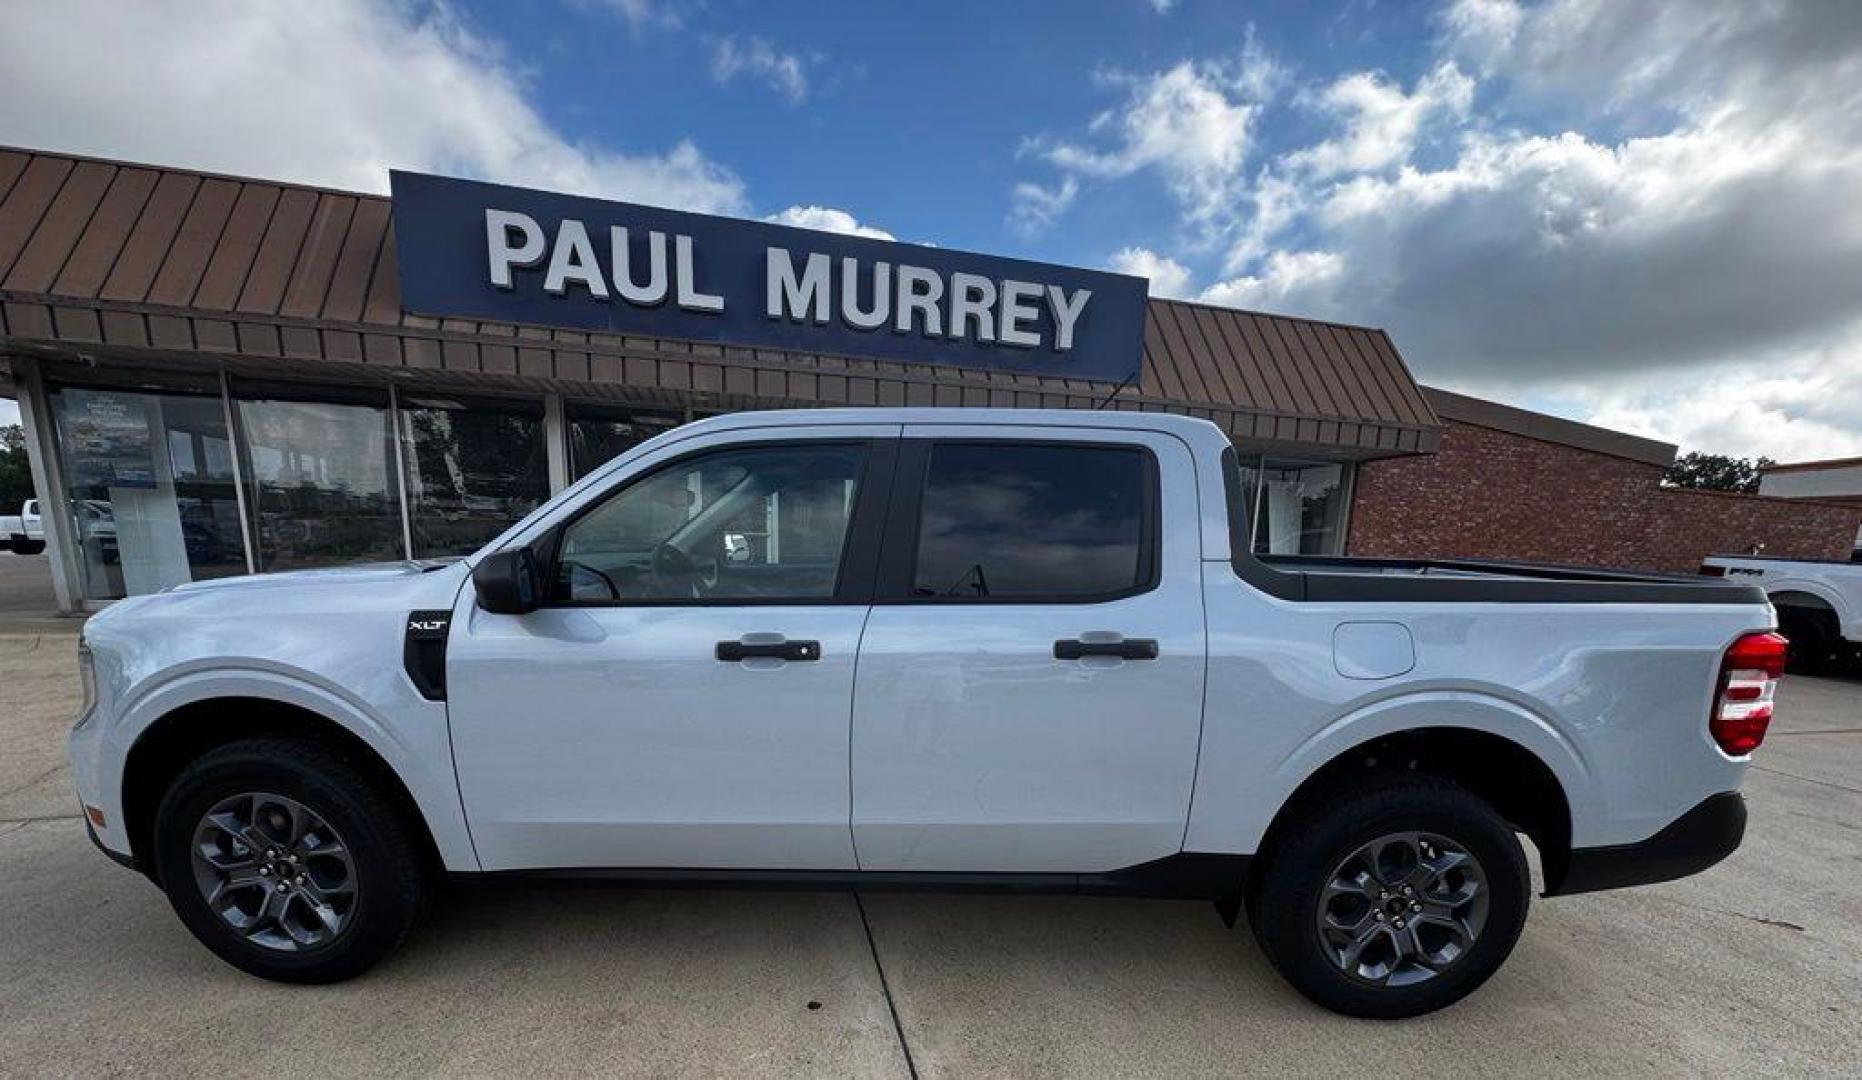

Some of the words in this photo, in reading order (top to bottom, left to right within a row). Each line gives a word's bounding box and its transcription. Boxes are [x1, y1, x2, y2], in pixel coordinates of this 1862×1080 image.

[485, 208, 725, 310] PAUL
[767, 247, 1092, 350] MURREY
[409, 621, 447, 630] XLT
